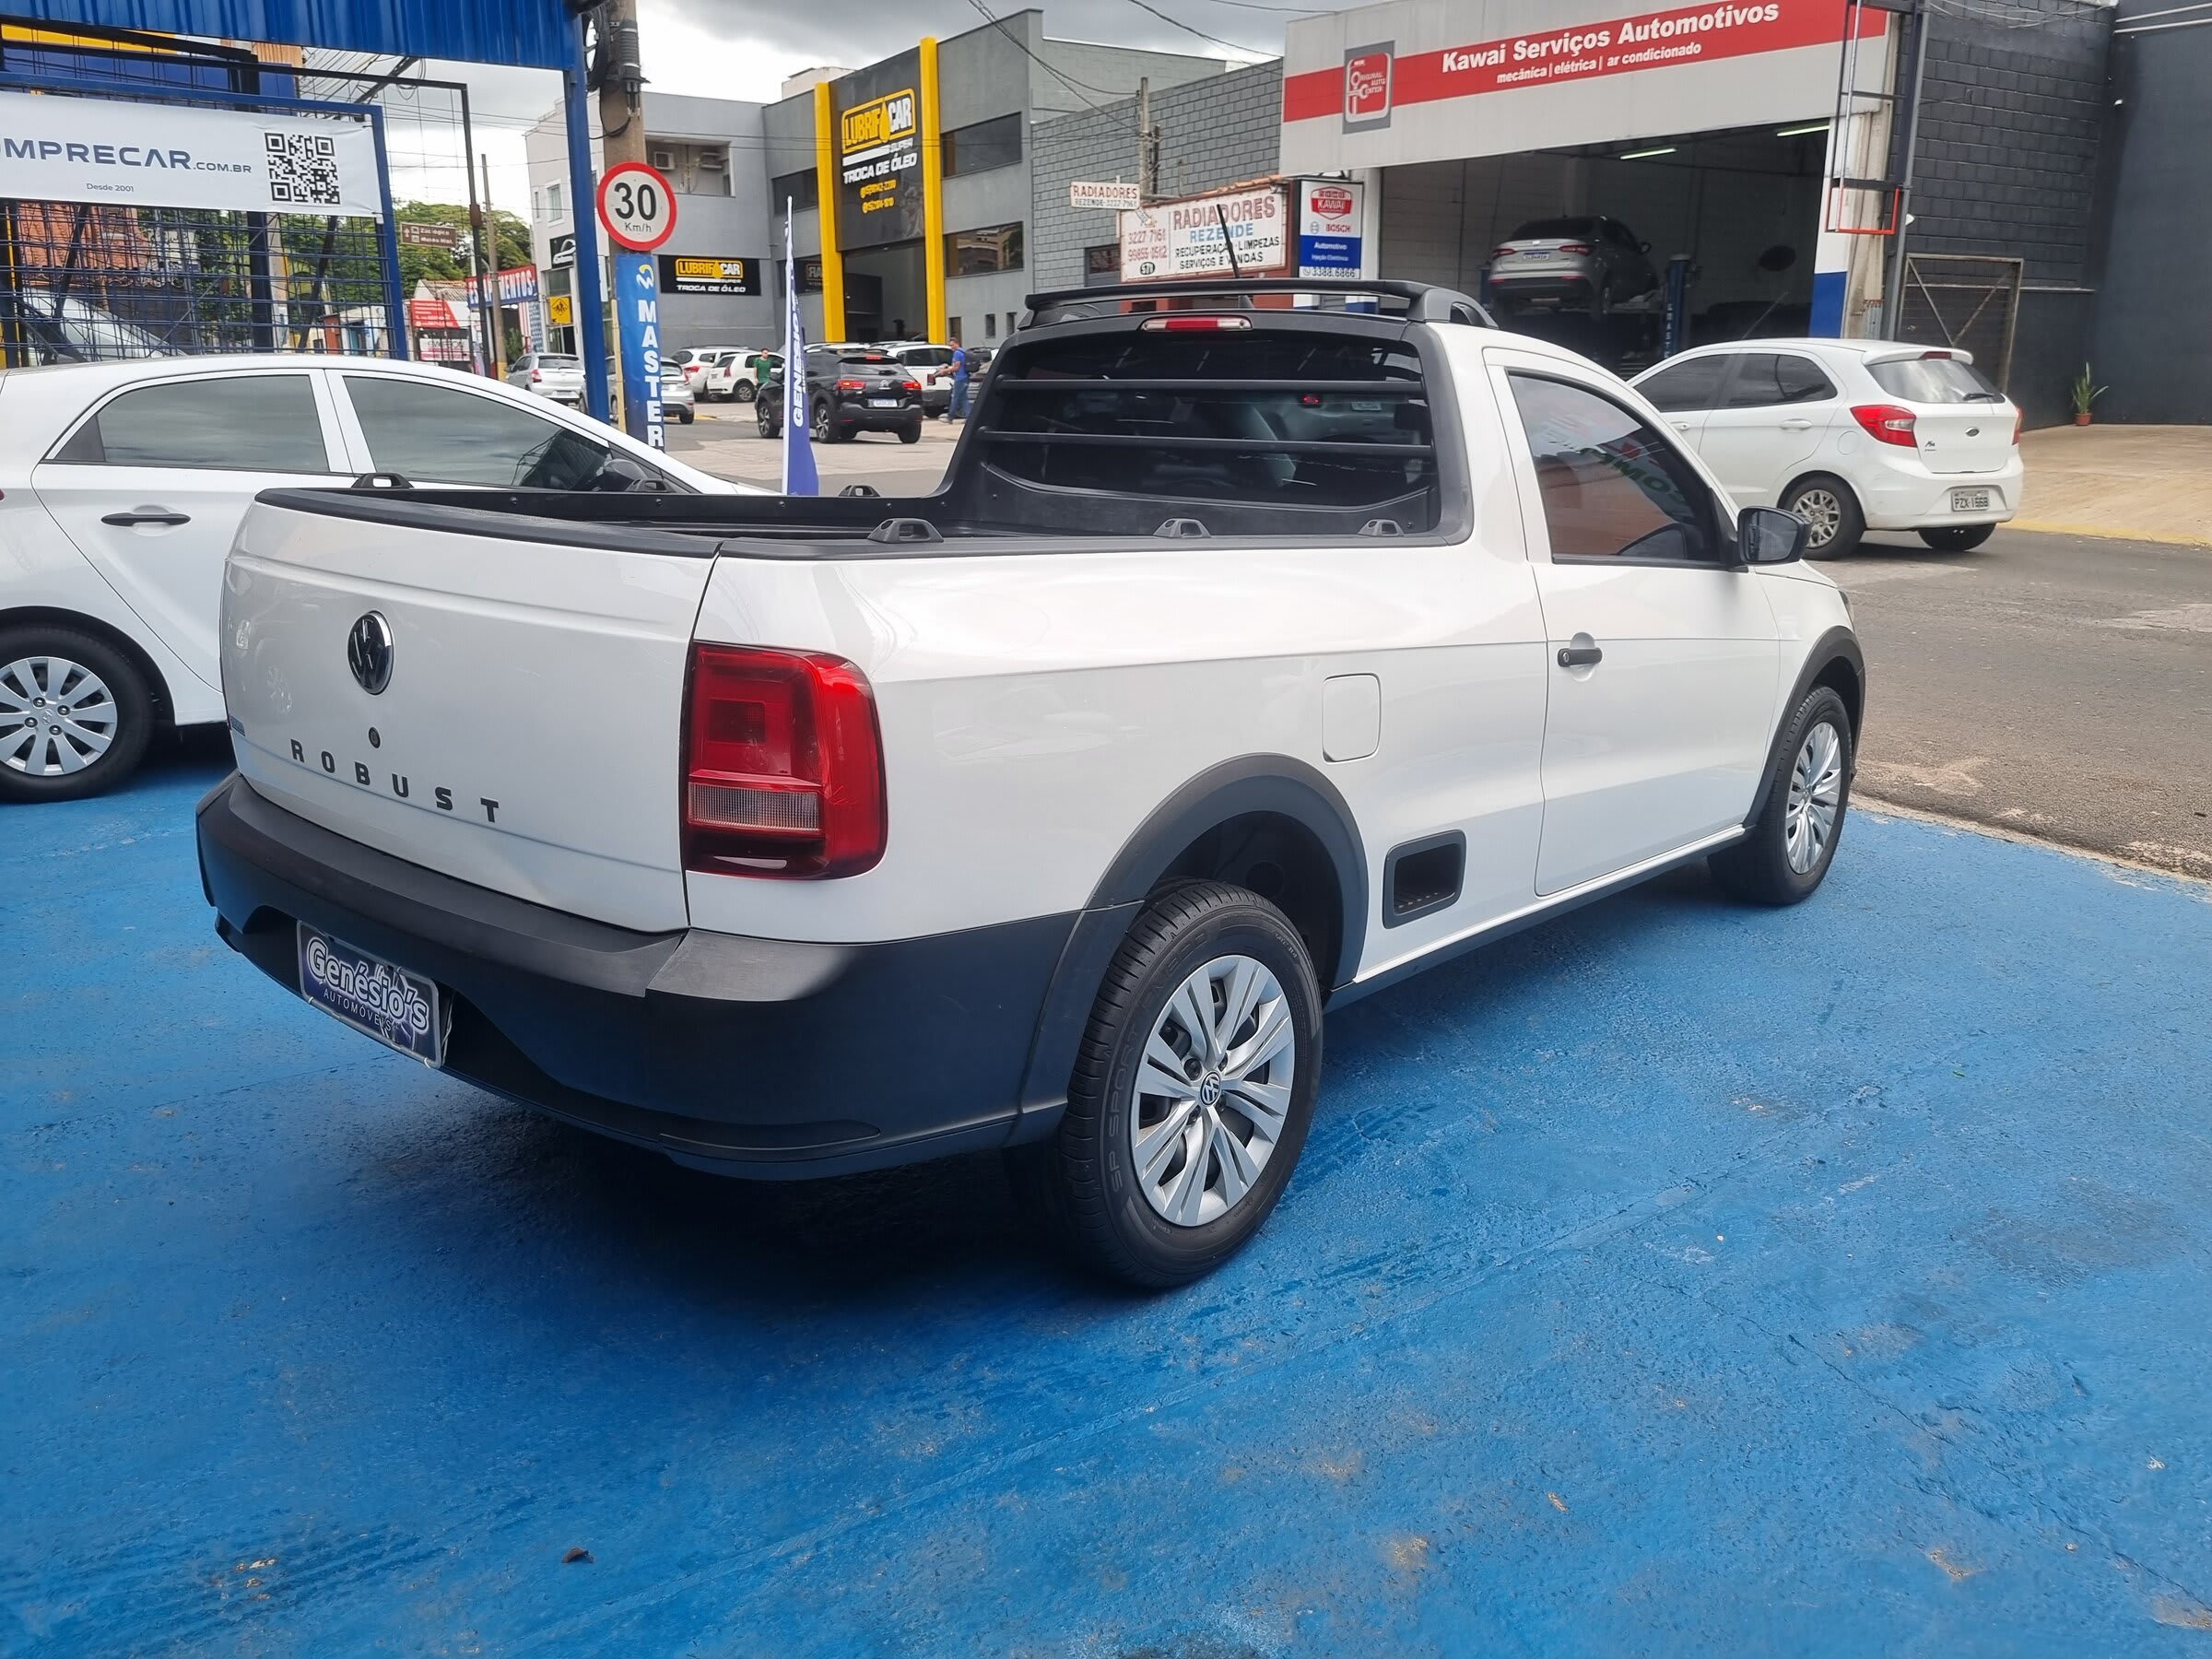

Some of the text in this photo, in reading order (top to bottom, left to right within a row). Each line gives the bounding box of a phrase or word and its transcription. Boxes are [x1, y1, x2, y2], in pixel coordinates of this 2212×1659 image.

[1442, 4, 1779, 73] Kawai Serviços Automotivos
[1497, 41, 1702, 84] mecânica elétrica ar condicionado
[0, 138, 252, 173] MPRECAR.COM.BR
[842, 152, 918, 184] TROCA DE ÓLEO
[87, 182, 135, 193] Desde 2001
[614, 182, 656, 220] 30
[1073, 184, 1137, 200] RADIADORES
[1173, 196, 1276, 230] RADIADORES
[1317, 199, 1346, 210] KAWAI
[625, 222, 652, 233] Km/h
[1325, 224, 1351, 233] BOSCH
[1175, 242, 1233, 258] RECUPERAÇ
[1219, 256, 1224, 265] E
[1226, 252, 1264, 265] VNDAS
[721, 284, 747, 293] ÓLEO
[638, 299, 665, 448] MASTER
[290, 738, 500, 824] ROBUST
[307, 937, 429, 1033] Genésio's
